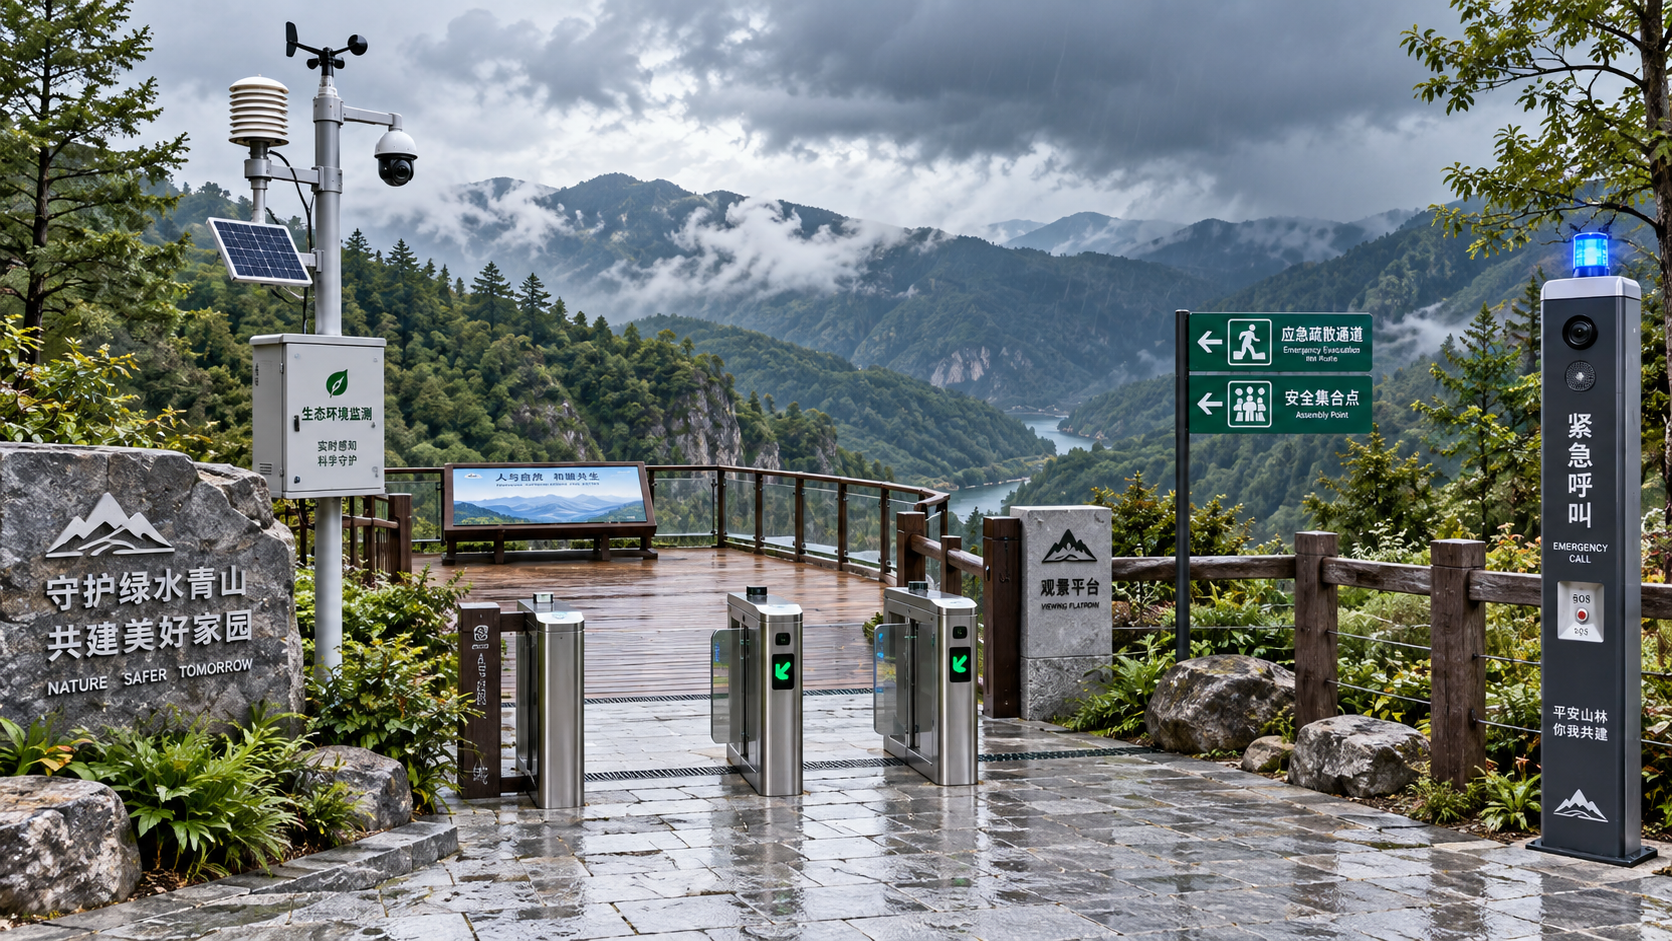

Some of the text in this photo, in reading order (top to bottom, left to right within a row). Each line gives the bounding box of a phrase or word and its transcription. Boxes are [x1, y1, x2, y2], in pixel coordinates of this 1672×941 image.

[1281, 326, 1363, 342] 应急疏散通道
[1285, 389, 1359, 406] 安全集合点
[302, 406, 373, 421] 生态环境监测
[318, 455, 357, 467] 科学守护
[1568, 413, 1592, 528] 紧急呼叫
[1553, 542, 1608, 552] EMERGENCY
[1569, 554, 1591, 564] CALL
[46, 565, 247, 611] 守护绿水青山
[1041, 577, 1099, 597] 观景平台
[48, 609, 252, 661] 共建美好家园
[48, 658, 253, 695] NATURE SAFER TOMORROW
[1553, 705, 1608, 724] 平安山林
[1553, 722, 1608, 742] 你我共建
